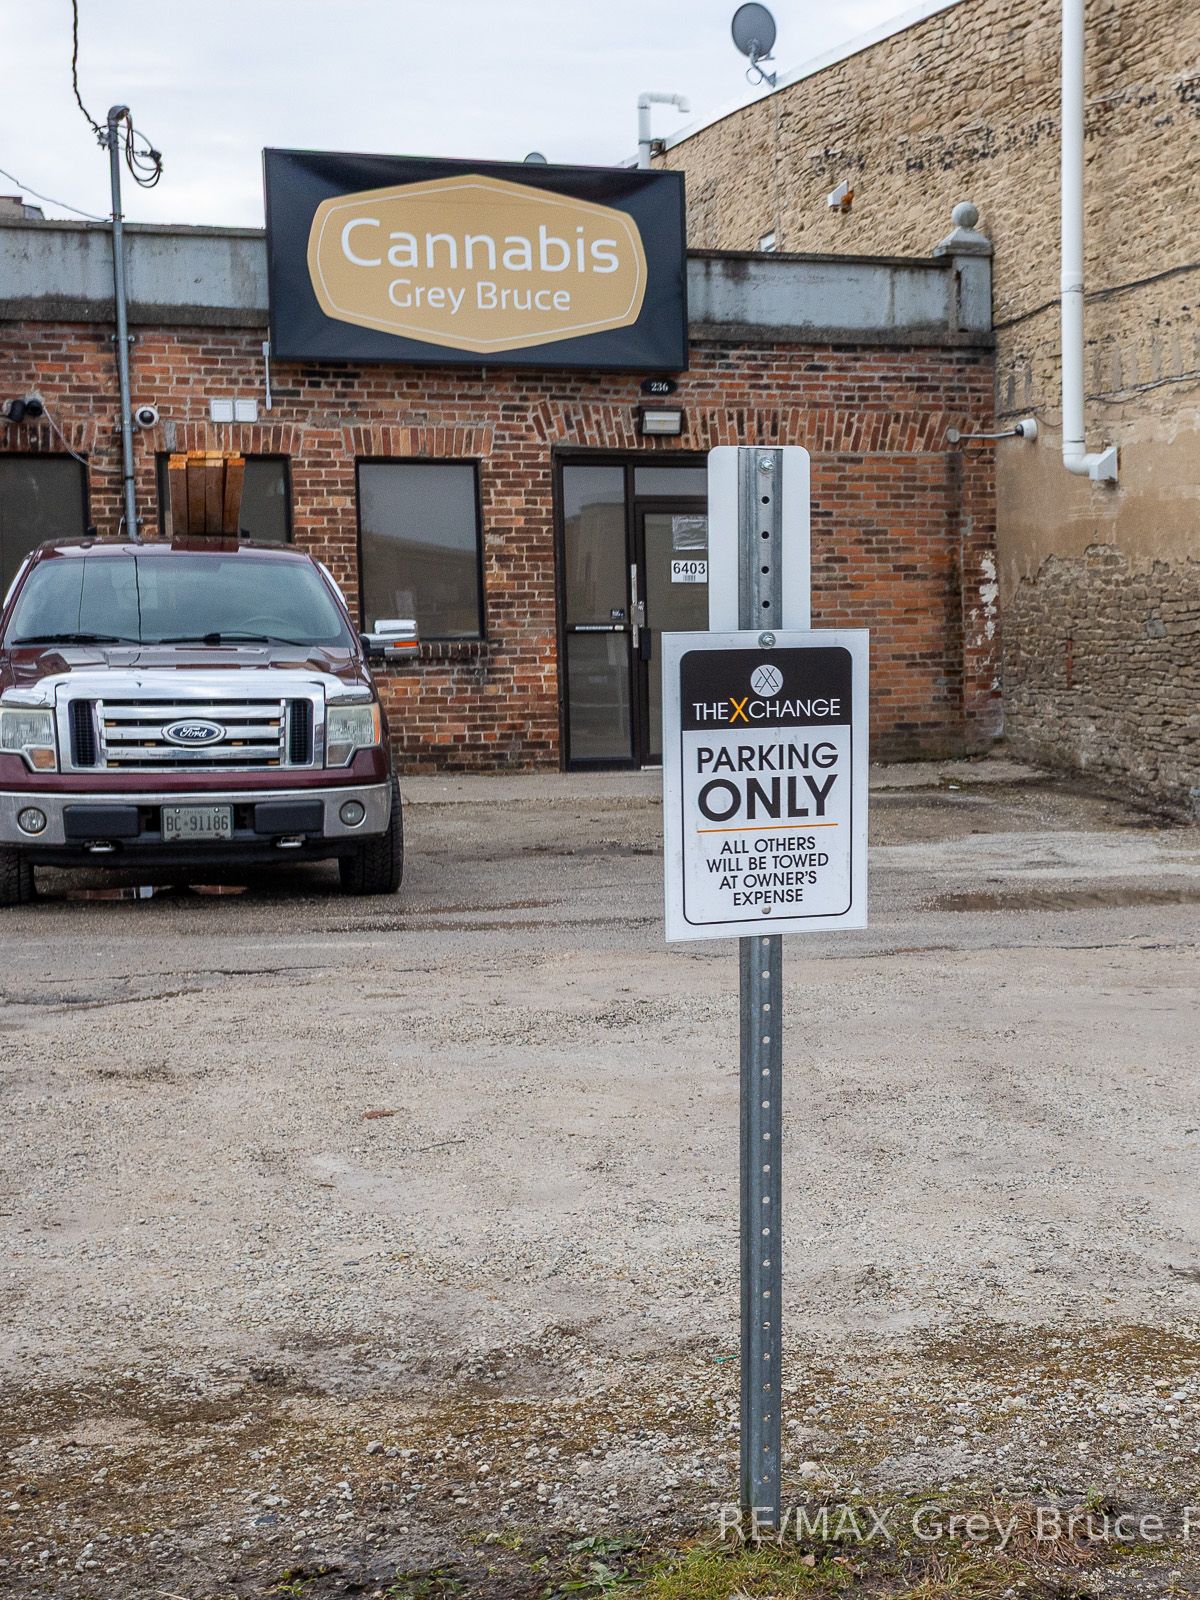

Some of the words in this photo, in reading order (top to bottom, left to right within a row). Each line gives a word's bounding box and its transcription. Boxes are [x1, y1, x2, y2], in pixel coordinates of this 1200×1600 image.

[340, 217, 620, 274] Cannabis
[388, 279, 466, 315] Grey
[477, 281, 571, 311] Bruce
[651, 382, 669, 392] 236
[673, 562, 706, 575] 6403
[180, 727, 207, 738] Ford
[697, 742, 838, 774] PARKING
[698, 774, 838, 822] ONLY
[720, 839, 749, 855] ALL
[754, 836, 816, 852] OTHERS
[706, 856, 743, 873] WILL
[749, 856, 767, 870] BE
[771, 853, 829, 869] TOWED
[719, 875, 741, 890] AT
[743, 870, 817, 889] OWNER'S
[733, 888, 804, 906] EXPENSE
